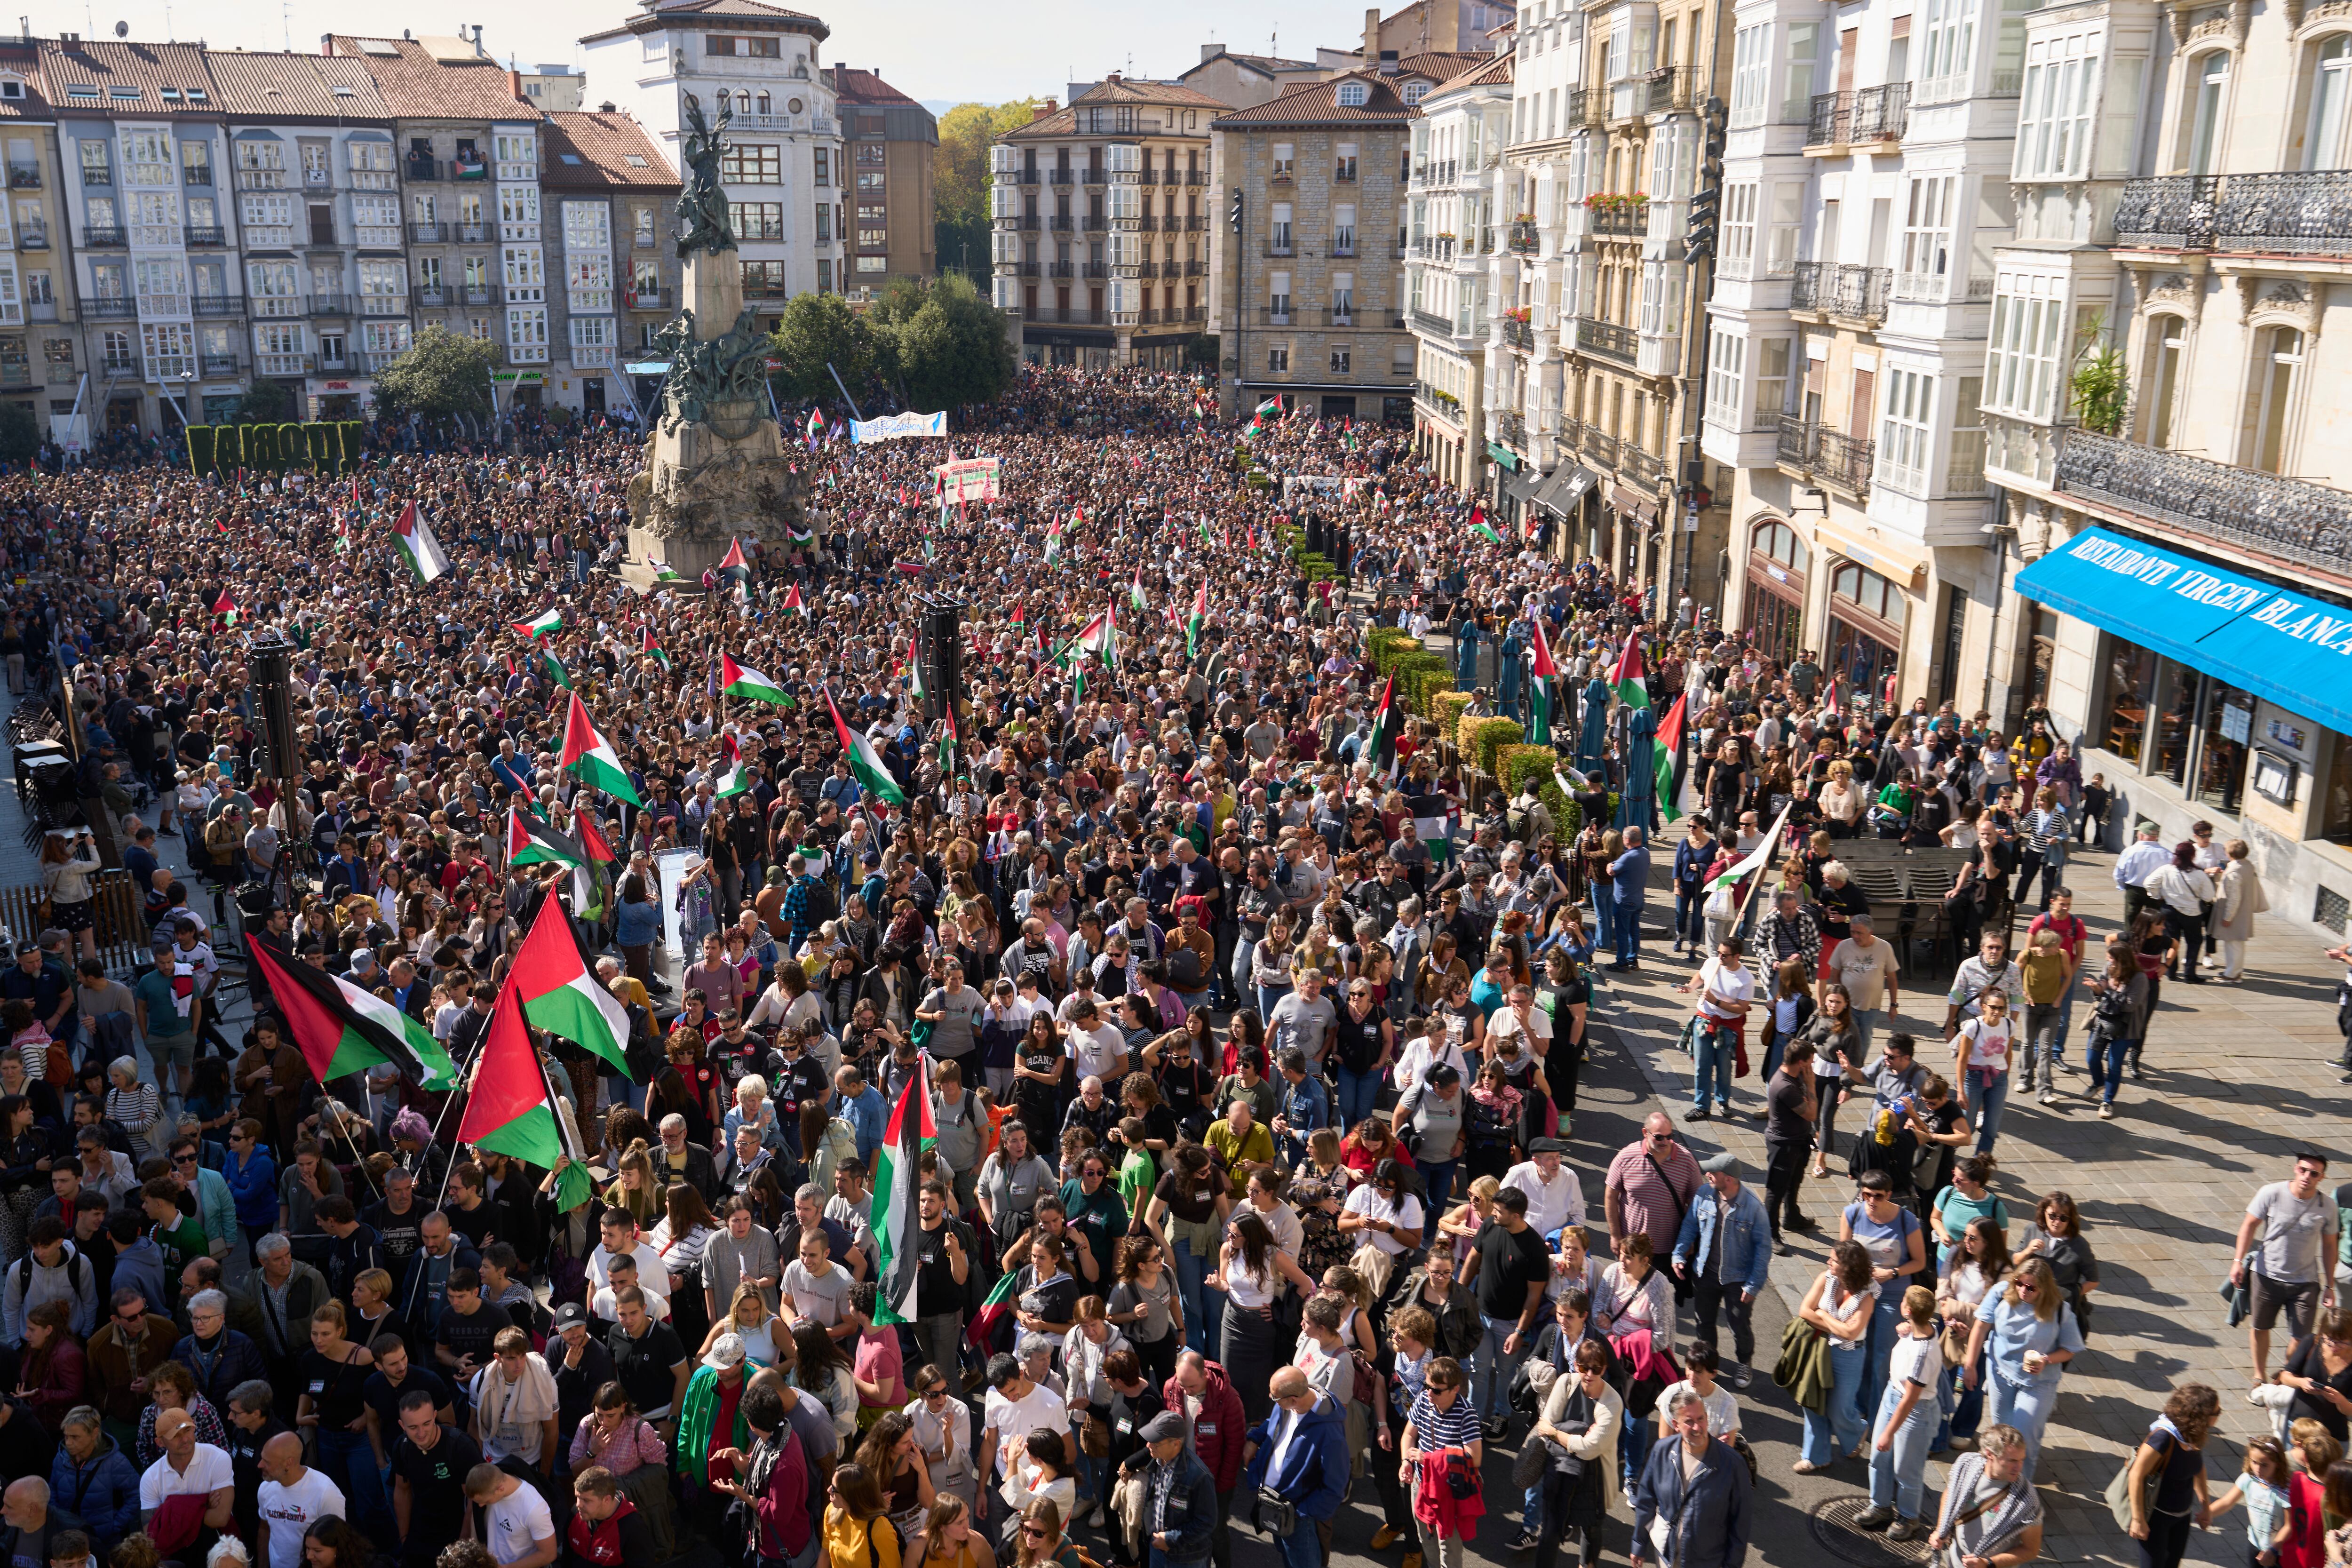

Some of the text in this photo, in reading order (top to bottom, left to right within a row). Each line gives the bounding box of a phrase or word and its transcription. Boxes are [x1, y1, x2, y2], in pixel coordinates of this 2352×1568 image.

[494, 370, 540, 382] armacia
[328, 382, 350, 390] PINK
[2067, 536, 2352, 656] RESTAURANTE VIRGEN BLANCA
[450, 1327, 489, 1335] REEBOK
[905, 1522, 922, 1533] LIBRE!
